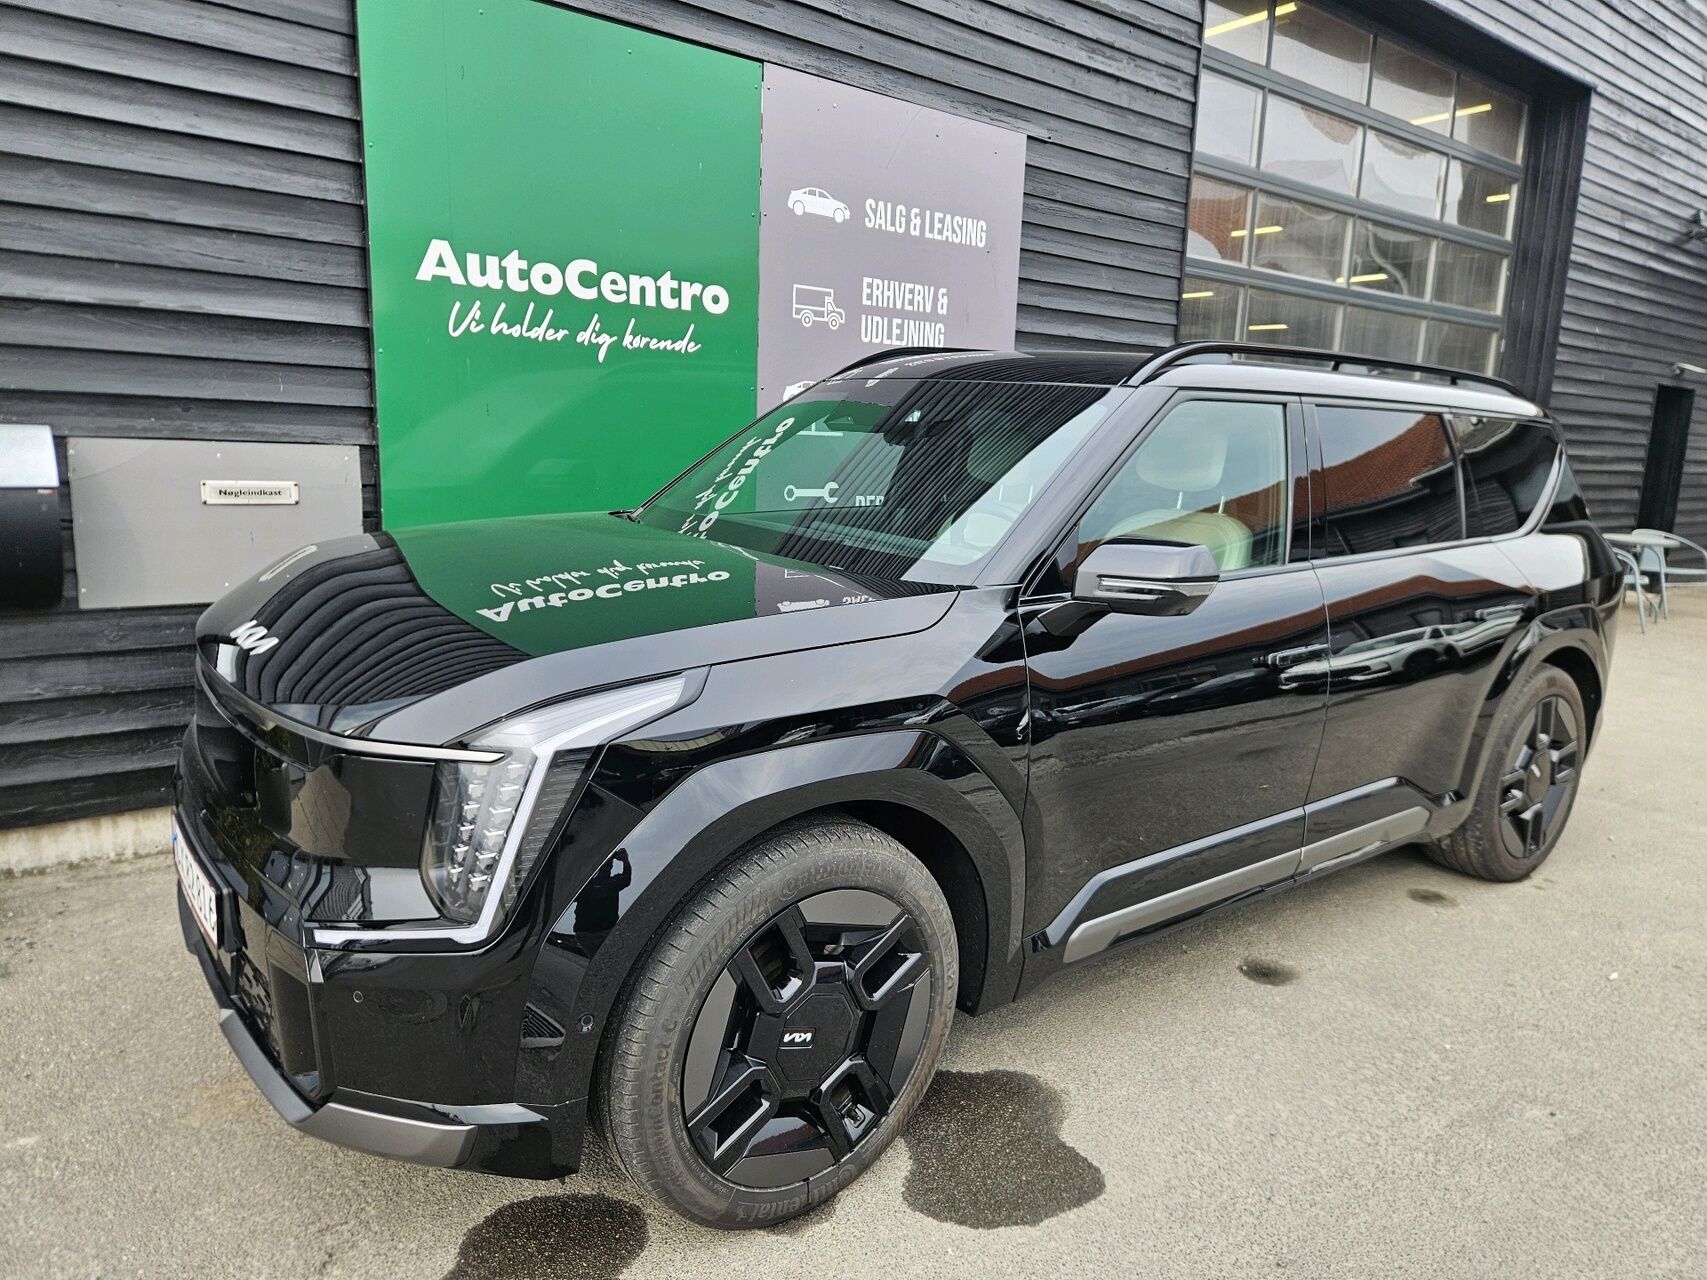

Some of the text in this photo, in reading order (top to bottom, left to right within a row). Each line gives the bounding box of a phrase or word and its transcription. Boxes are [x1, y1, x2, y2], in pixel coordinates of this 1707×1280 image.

[864, 198, 988, 248] SALG & LEASING
[415, 238, 730, 315] AutoCentro
[862, 276, 949, 315] ERHVERV &
[448, 300, 486, 338] Vi
[490, 301, 570, 343] holder
[576, 313, 618, 363] dig
[860, 314, 945, 348] UDLEJNING
